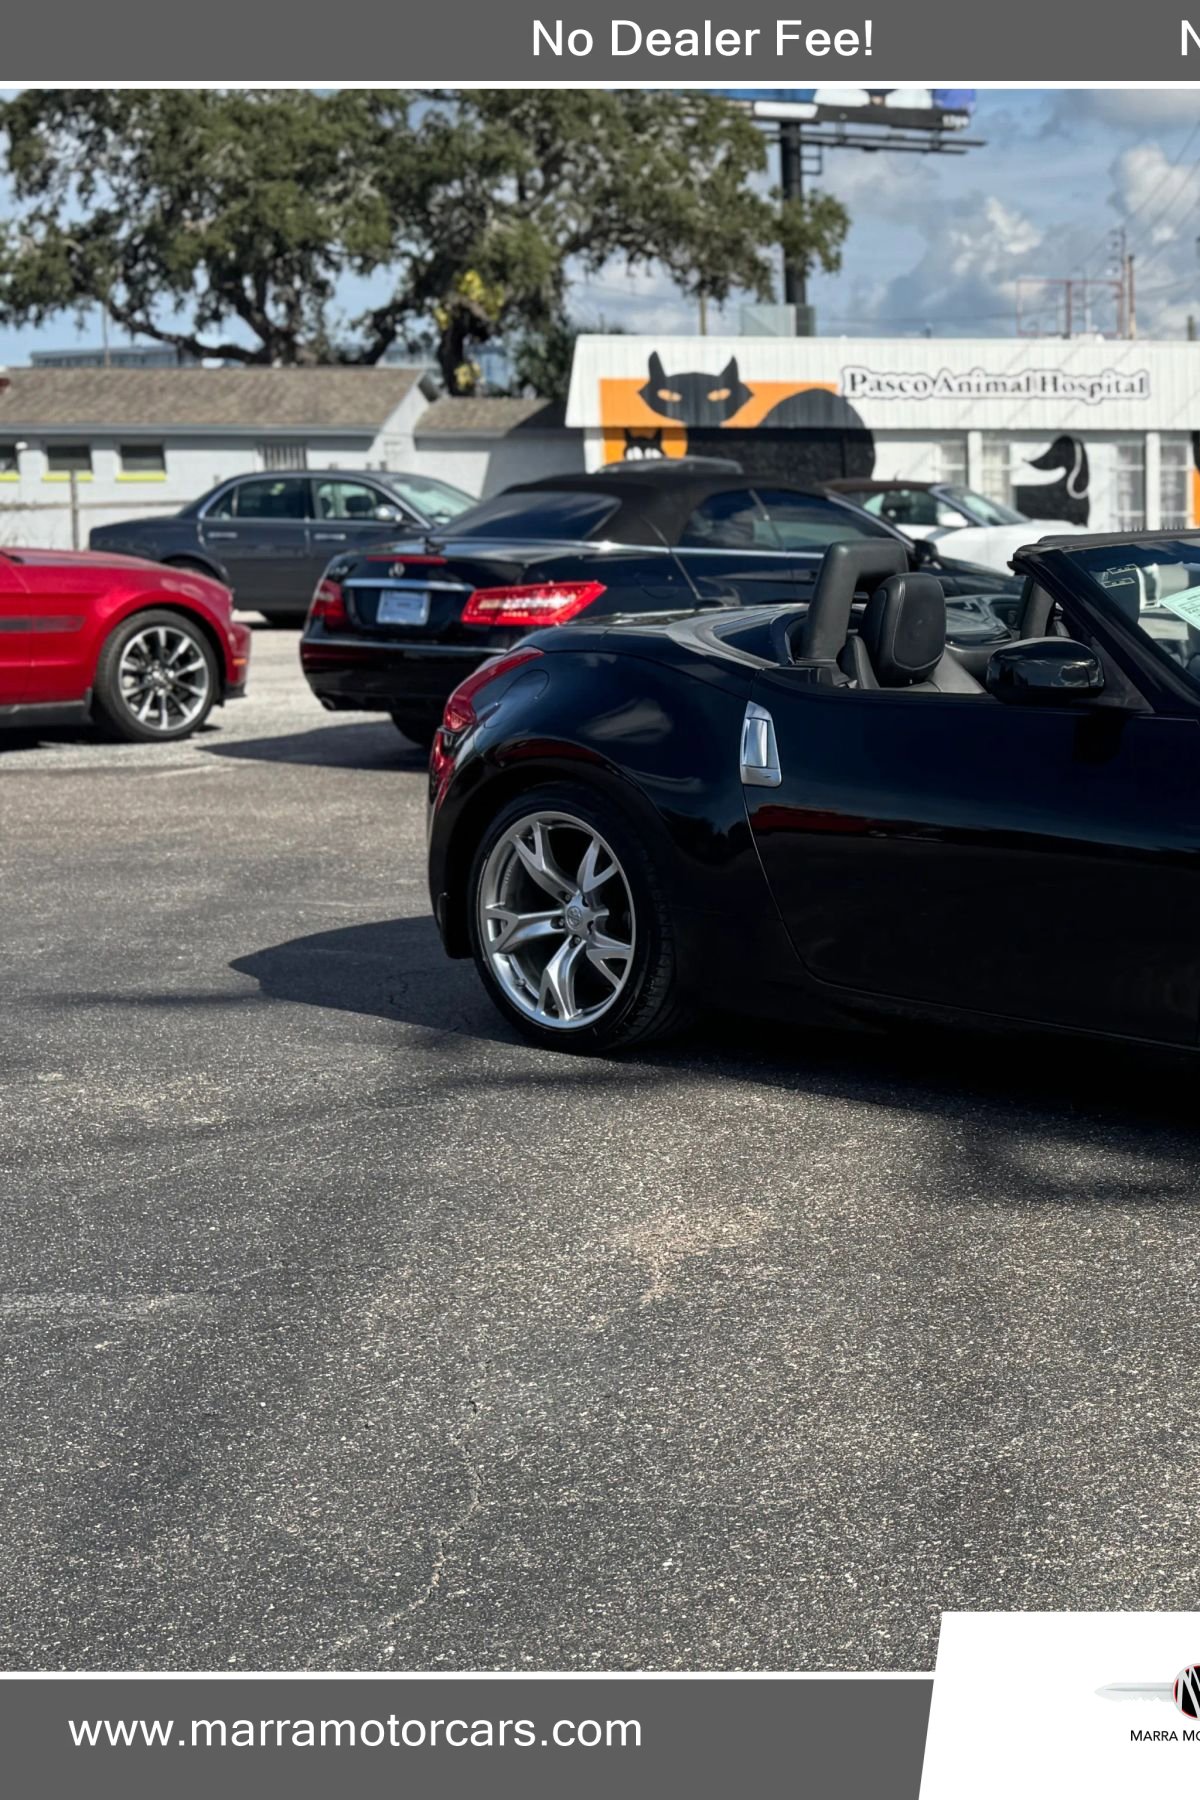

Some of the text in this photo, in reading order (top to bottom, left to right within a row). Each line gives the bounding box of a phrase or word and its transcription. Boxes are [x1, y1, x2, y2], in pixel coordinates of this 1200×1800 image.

[849, 372, 1147, 398] Pasco Animal Hospital
